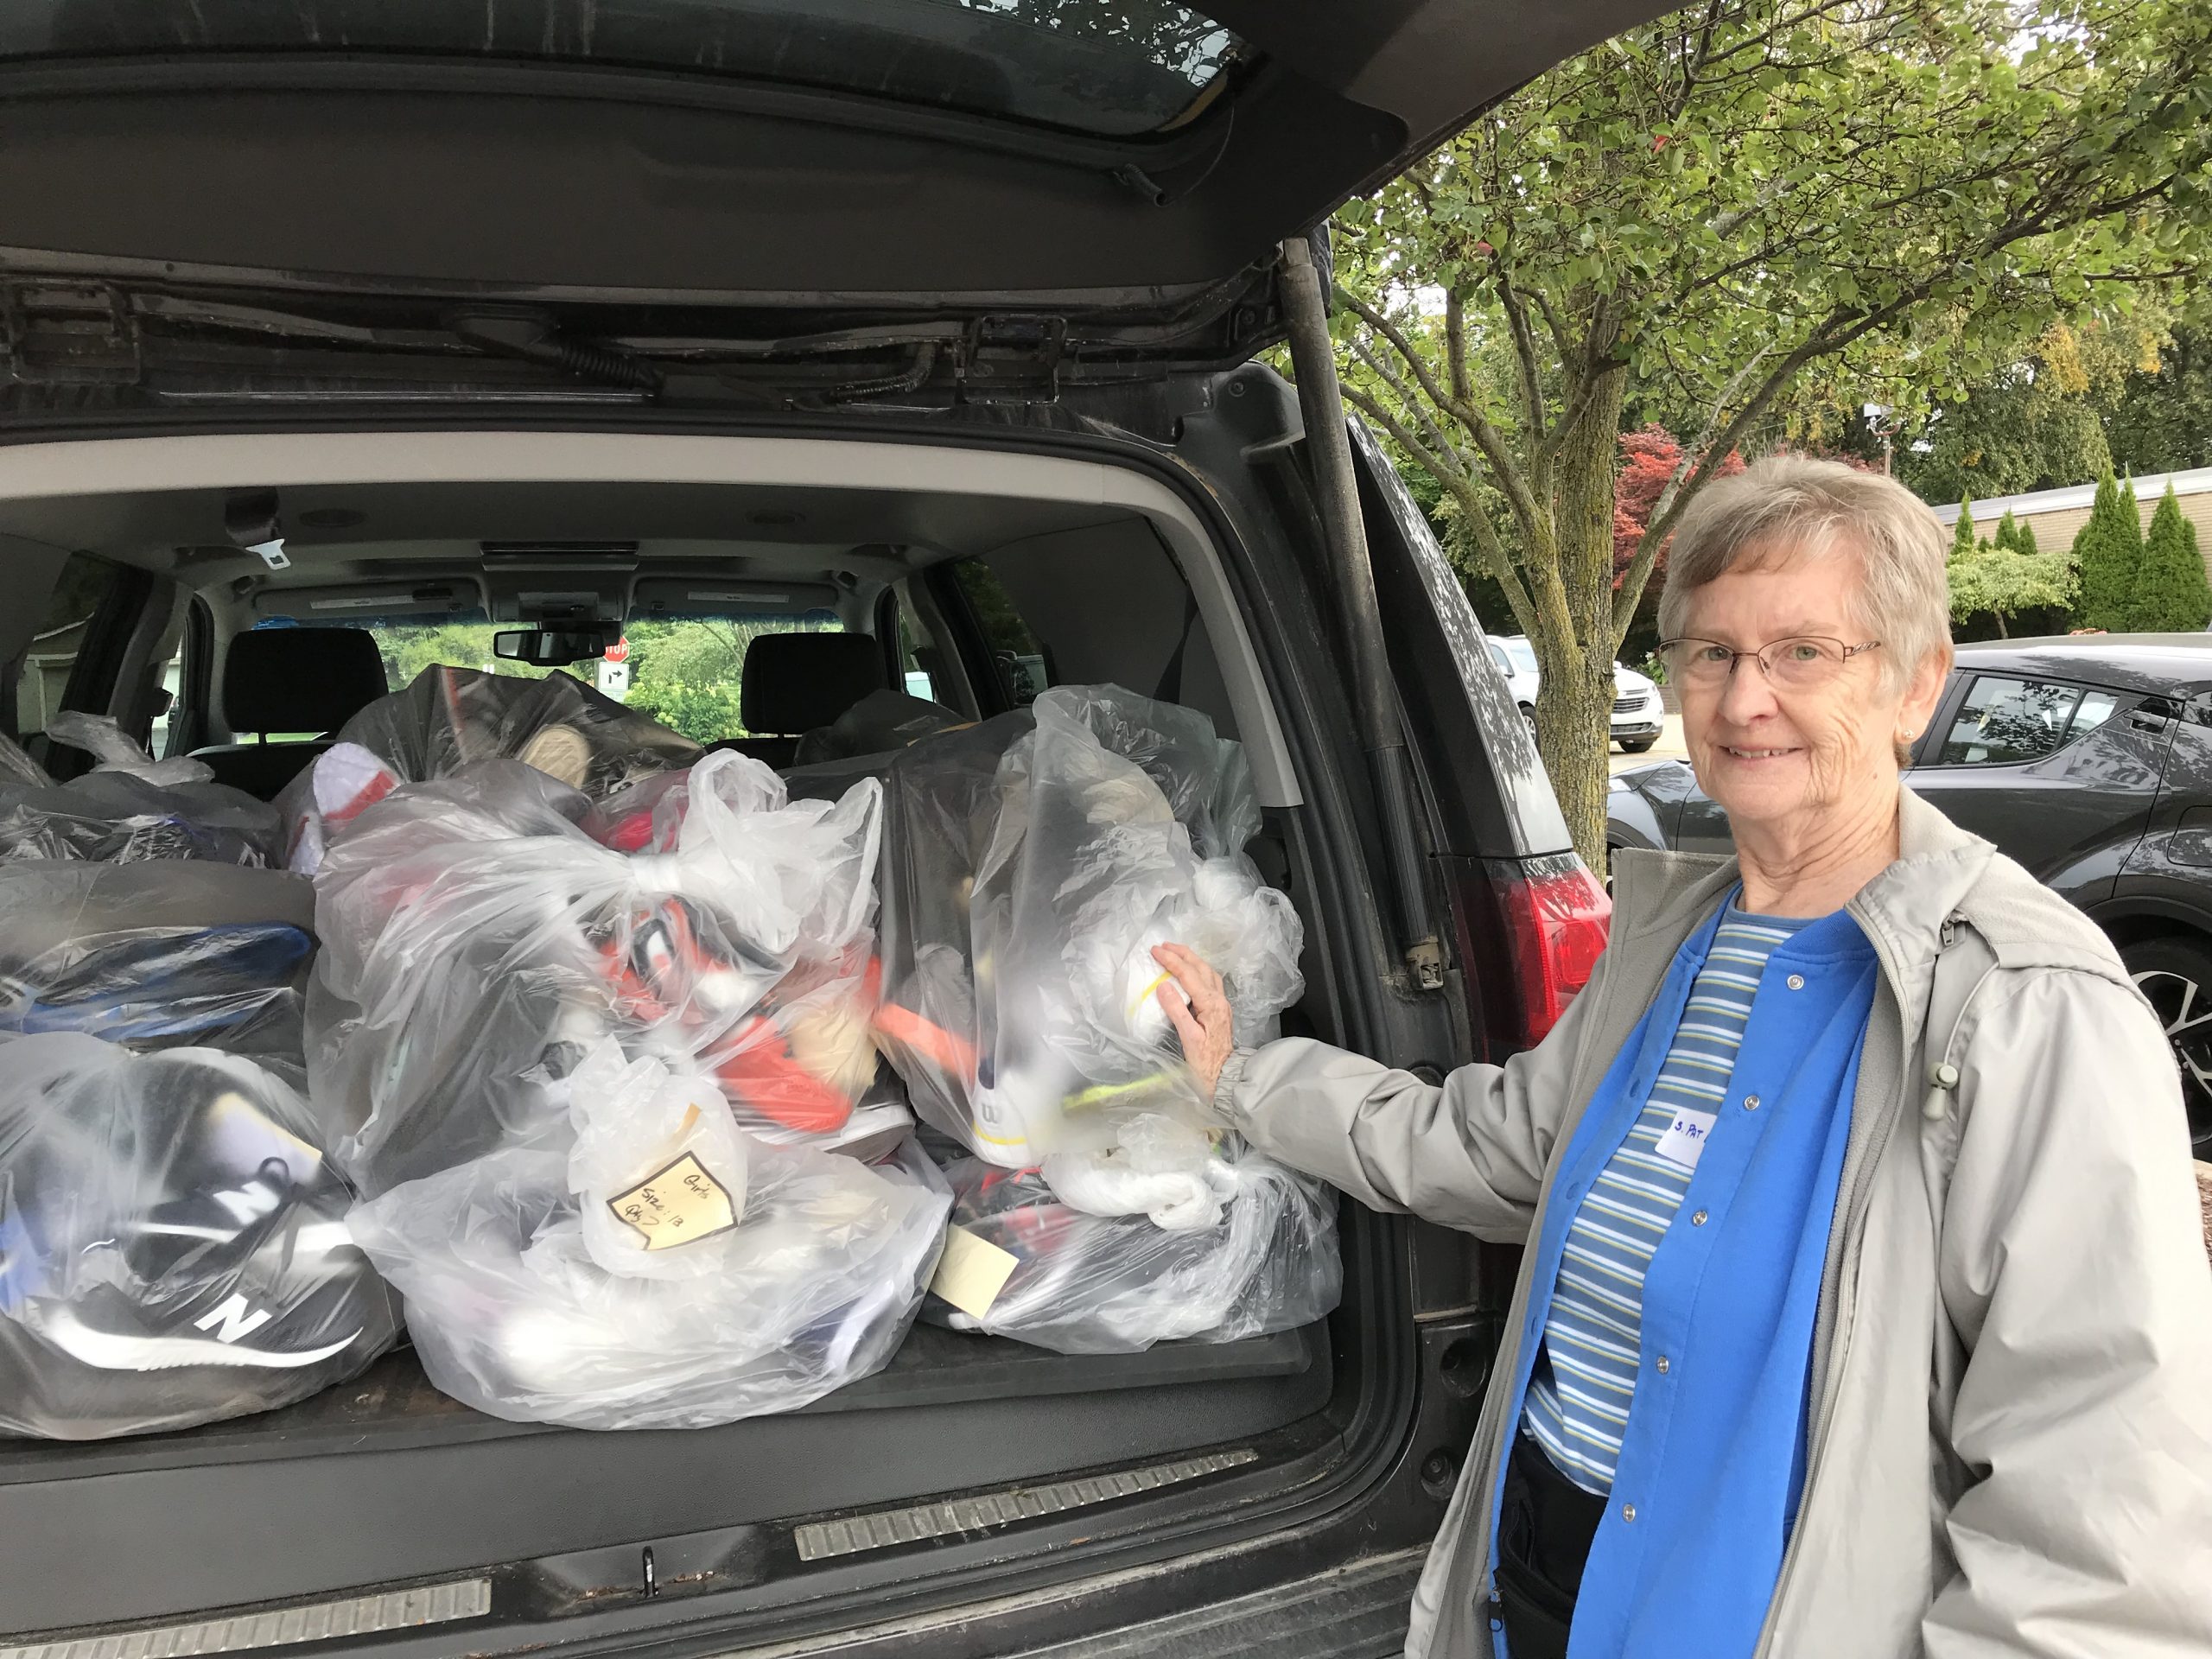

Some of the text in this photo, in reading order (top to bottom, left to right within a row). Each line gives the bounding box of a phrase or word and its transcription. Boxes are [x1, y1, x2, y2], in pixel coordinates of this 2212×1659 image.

[1686, 1123, 1704, 1139] PAT
[213, 1180, 281, 1225] N
[683, 1174, 711, 1199] Girls
[194, 1293, 273, 1344] N
